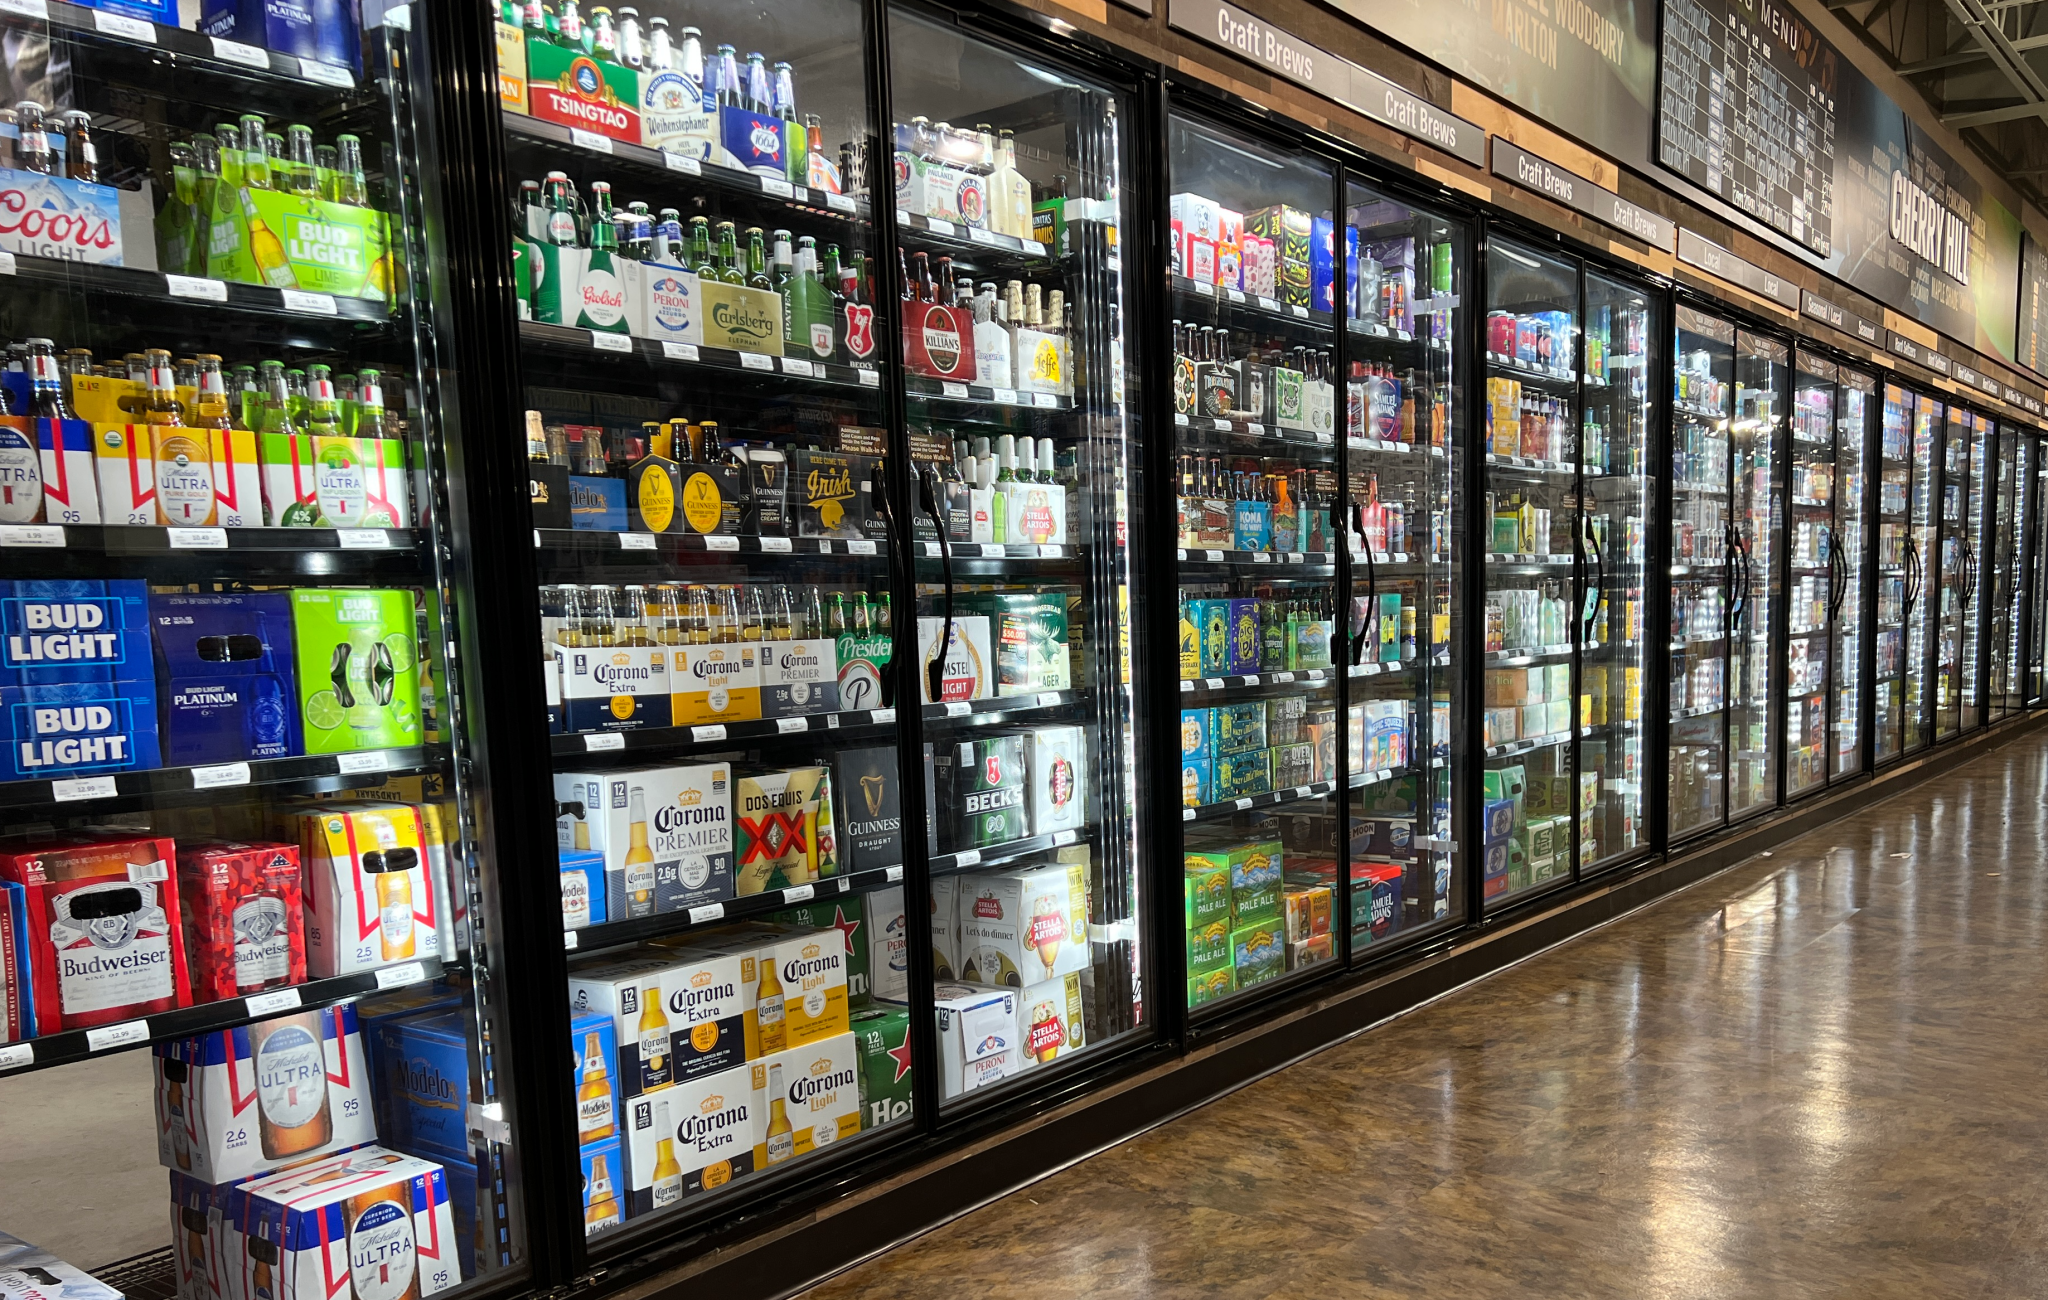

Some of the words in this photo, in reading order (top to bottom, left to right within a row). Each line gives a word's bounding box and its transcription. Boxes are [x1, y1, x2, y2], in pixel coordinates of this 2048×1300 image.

[267, 3, 312, 23] PLATINUM
[1555, 0, 1624, 66] WOODBURY
[1761, 0, 1797, 51] MENU
[1217, 9, 1261, 56] Craft
[1265, 30, 1313, 81] Brews
[500, 82, 518, 98] AN
[550, 93, 627, 129] TSINGTAO
[1385, 91, 1417, 126] Craft
[1419, 106, 1456, 148] Brews
[646, 115, 710, 136] Weihenstephaner
[678, 140, 691, 149] HEFE
[754, 131, 776, 151] 1664
[928, 168, 954, 181] PAULANER
[1518, 155, 1543, 188] Craft
[1545, 174, 1573, 201] Brews
[0, 190, 115, 249] Coors
[550, 221, 575, 234] Grolsch
[1033, 214, 1052, 226] UNITAS
[1613, 201, 1633, 226] Craft
[1634, 214, 1657, 240] Brews
[1890, 169, 1945, 268] CHERRY
[1943, 211, 1969, 286] HILL
[298, 219, 349, 247] BUD
[290, 239, 359, 267] LIGHT
[1704, 246, 1721, 271] Local
[314, 269, 340, 285] LIME
[1764, 276, 1779, 298] Local
[582, 285, 622, 308] Grolsch
[653, 291, 690, 310] PERONI
[784, 288, 792, 341] SPATEN
[1808, 296, 1828, 320] Seasonal
[1831, 309, 1843, 326] Local
[712, 303, 773, 337] Carlsberg
[1858, 320, 1875, 341] Seasonal
[728, 336, 761, 347] ELEPHANT
[925, 334, 960, 351] KILLIAN'S
[850, 360, 874, 370] BECK'S
[1036, 353, 1057, 377] Leffe
[841, 443, 860, 452] Please
[860, 445, 880, 454] Walk-In
[916, 452, 933, 460] Please
[933, 453, 951, 461] Walk-In
[810, 455, 823, 464] HERE
[823, 456, 837, 466] COME
[837, 458, 848, 467] THE
[161, 477, 210, 491] ULTRA
[320, 476, 362, 490] ULTRA
[807, 467, 856, 500] Irish
[164, 489, 184, 498] PURE
[185, 489, 208, 499] GOLD
[292, 510, 311, 523] 4%
[1026, 511, 1050, 521] STELLA
[1239, 511, 1262, 524] KONA
[1026, 520, 1050, 530] ARTOIS
[27, 533, 42, 541] 8.99
[1002, 628, 1027, 640] $50,000
[10, 633, 117, 661] LIGHT
[1268, 647, 1280, 659] IPA
[677, 653, 684, 664] 6
[780, 653, 818, 670] Corona
[594, 664, 650, 684] Corona
[693, 660, 741, 680] Corona
[943, 661, 969, 676] MSTEL
[203, 685, 226, 693] LIGHT
[942, 682, 967, 696] LIGHT
[1037, 674, 1060, 688] LAGER
[1285, 699, 1306, 713] OVER
[35, 706, 112, 734] BUD
[1372, 720, 1387, 732] EPIC
[1387, 717, 1404, 729] SQUEEZE
[22, 735, 127, 767] LIGHT
[1290, 746, 1310, 758] OVER
[357, 787, 403, 800] LANDSHARK
[746, 793, 769, 812] DOS
[771, 790, 803, 808] EQUIS
[655, 803, 726, 833] Corona
[848, 817, 900, 836] GUINNESS
[1260, 818, 1278, 829] MOON
[1352, 823, 1374, 837] MOON
[26, 860, 44, 873] 12
[1068, 872, 1083, 886] WIN
[1370, 905, 1392, 922] ADAMS
[966, 926, 980, 938] Let's
[981, 928, 990, 938] do
[990, 928, 1014, 941] dinner
[1033, 918, 1061, 932] STELLA
[234, 943, 289, 963] Budweiser
[7, 956, 15, 984] AMERICA
[63, 949, 167, 977] Budweiser
[783, 952, 840, 985] Corona
[8, 986, 15, 994] IN
[1065, 976, 1079, 992] WIN
[669, 982, 735, 1016] Corona
[111, 1030, 130, 1039] 12.99
[1032, 1023, 1059, 1038] STELLA
[1032, 1032, 1060, 1049] ARTOIS
[975, 1054, 1006, 1074] PERONI
[261, 1063, 322, 1089] ULTRA
[398, 1058, 450, 1099] Modelo
[979, 1069, 1003, 1082] AZZURRO
[788, 1069, 855, 1104] Corona
[582, 1100, 610, 1116] Modelo
[809, 1092, 838, 1113] Light
[345, 1110, 359, 1118] CALS
[677, 1103, 749, 1141] Corona
[416, 1178, 424, 1187] 12
[431, 1172, 440, 1183] 12
[360, 1227, 402, 1250] Michelob
[353, 1236, 413, 1268] ULTRA
